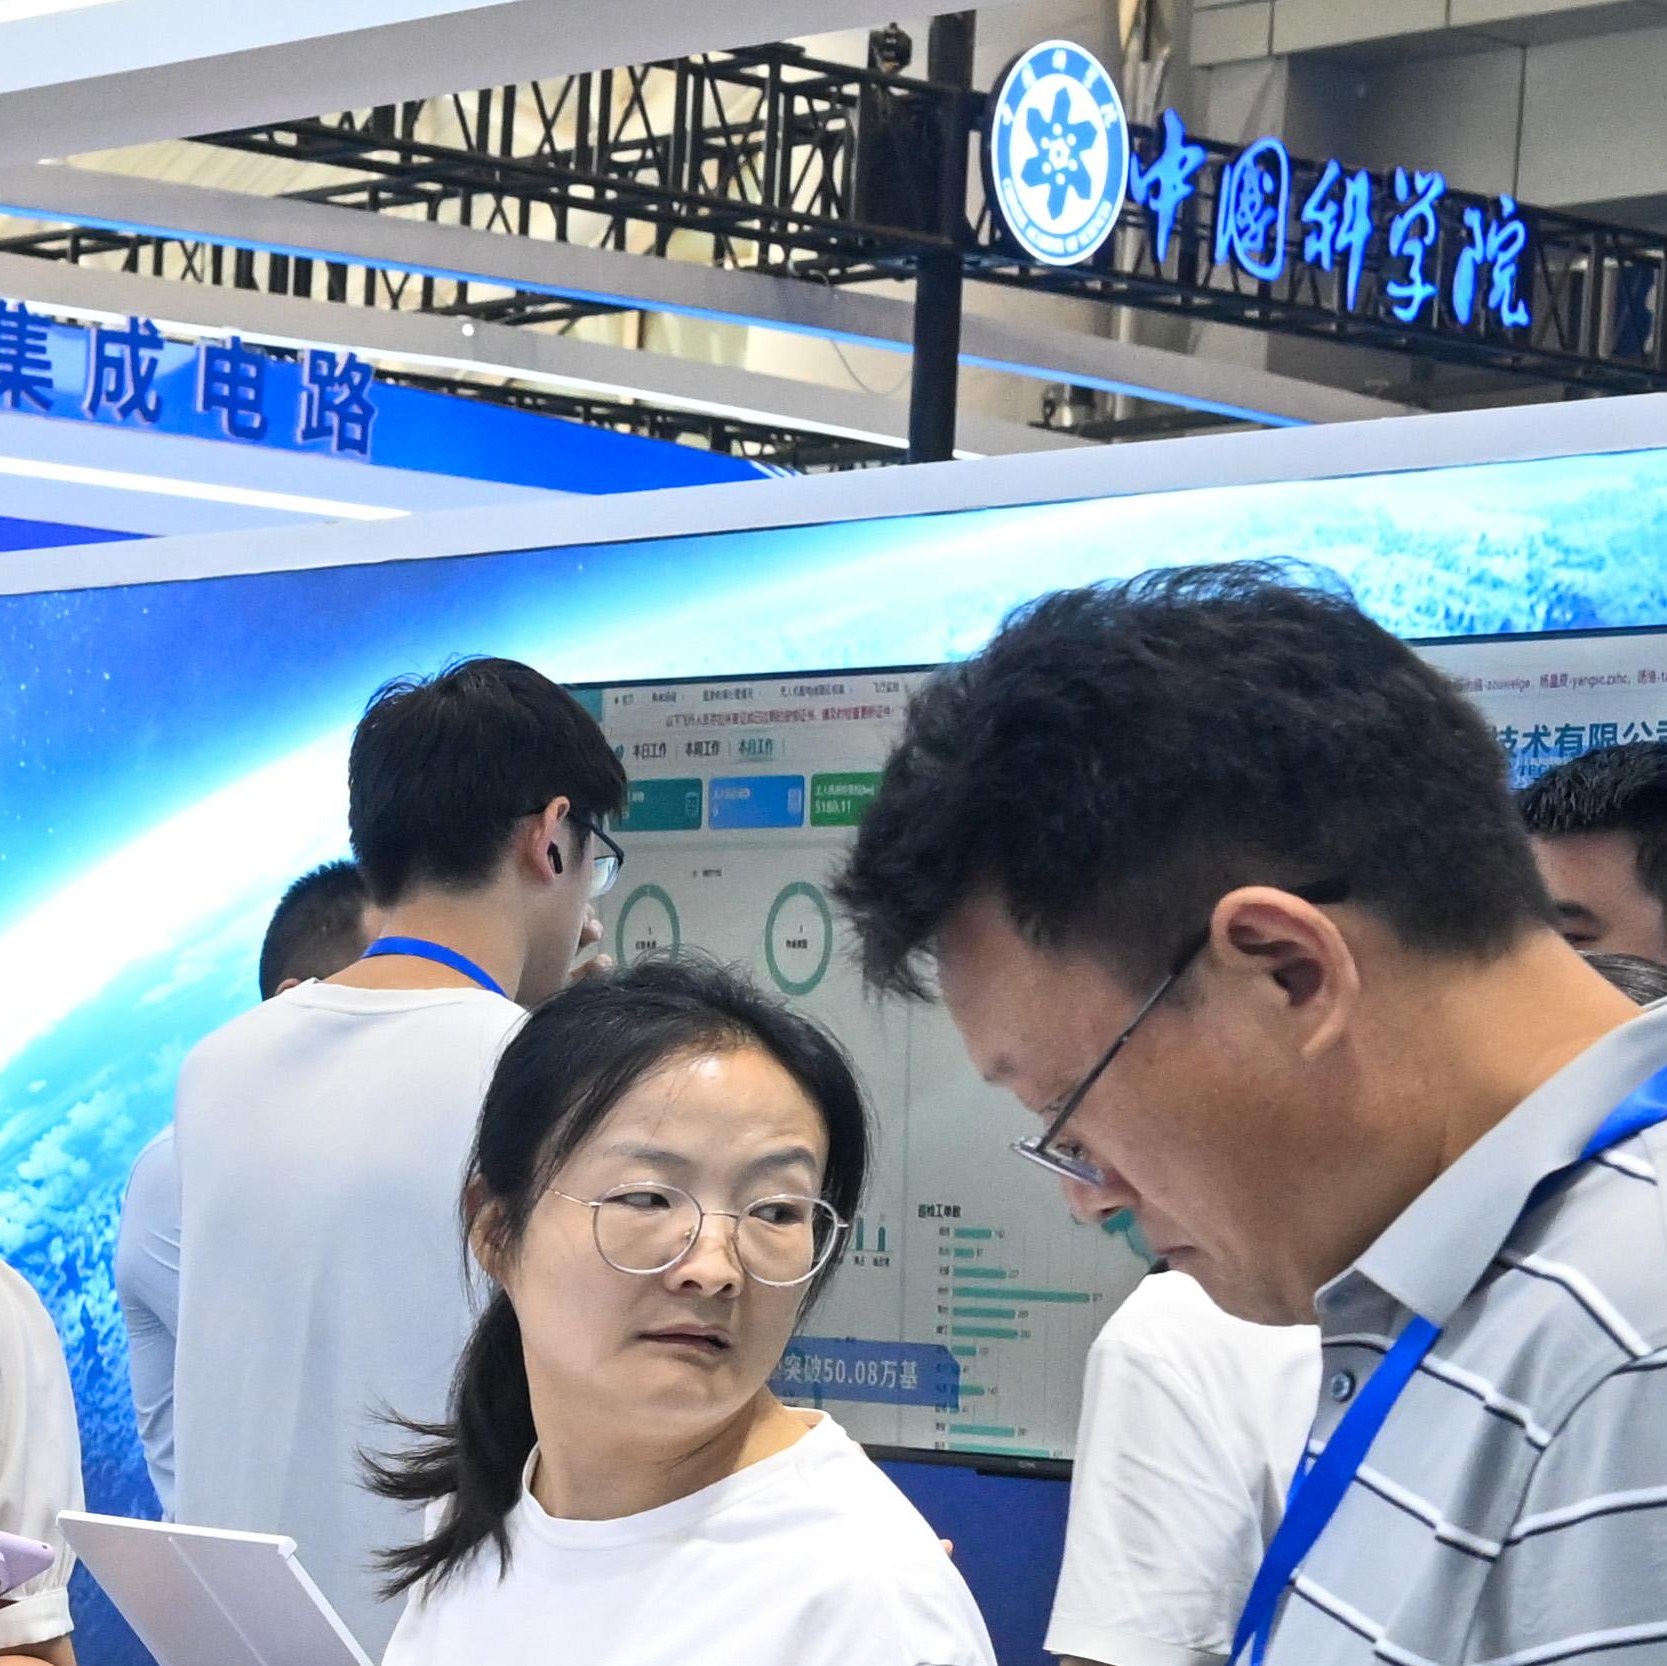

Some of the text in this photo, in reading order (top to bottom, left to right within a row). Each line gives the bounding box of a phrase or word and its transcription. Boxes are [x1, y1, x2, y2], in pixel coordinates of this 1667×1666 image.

[1493, 719, 1667, 759] 技术有限公
[777, 1353, 919, 1390] 突破50.08万基
